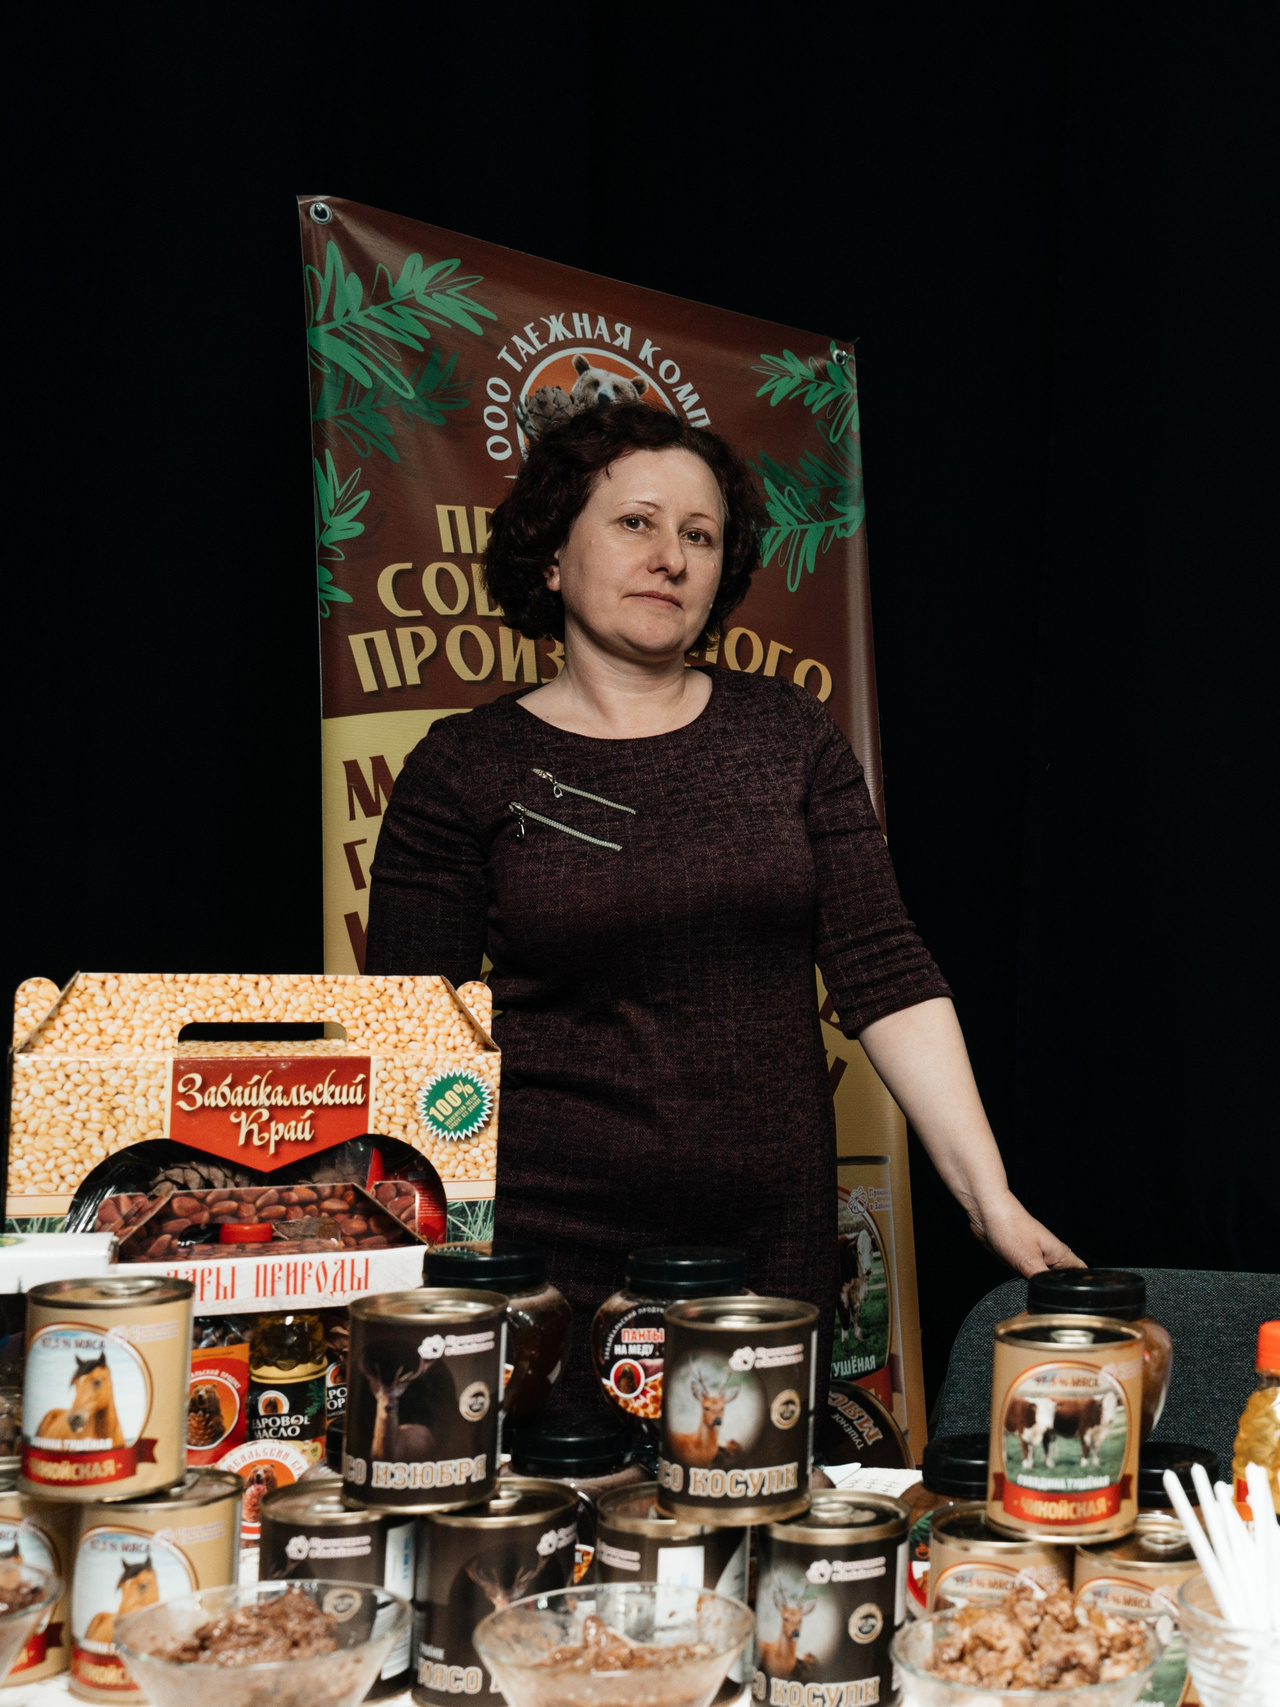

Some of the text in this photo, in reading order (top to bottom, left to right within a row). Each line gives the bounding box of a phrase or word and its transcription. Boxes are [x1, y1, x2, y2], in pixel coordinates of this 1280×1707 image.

[497, 313, 632, 372] ТАЕЖНАЯ
[483, 378, 512, 461] ООО
[176, 1069, 367, 1112] Забайкальский
[428, 1079, 475, 1122] 100%
[229, 1109, 315, 1156] Край
[255, 1257, 370, 1299] ПРИРОДЫ
[614, 1344, 655, 1357] НА МЕДУ
[621, 1327, 665, 1344] ПАНТЫ
[254, 1425, 301, 1440] МАСЛО
[371, 1453, 488, 1490] ИЗЮБРЯ
[688, 1461, 799, 1498] КОСУЛИ
